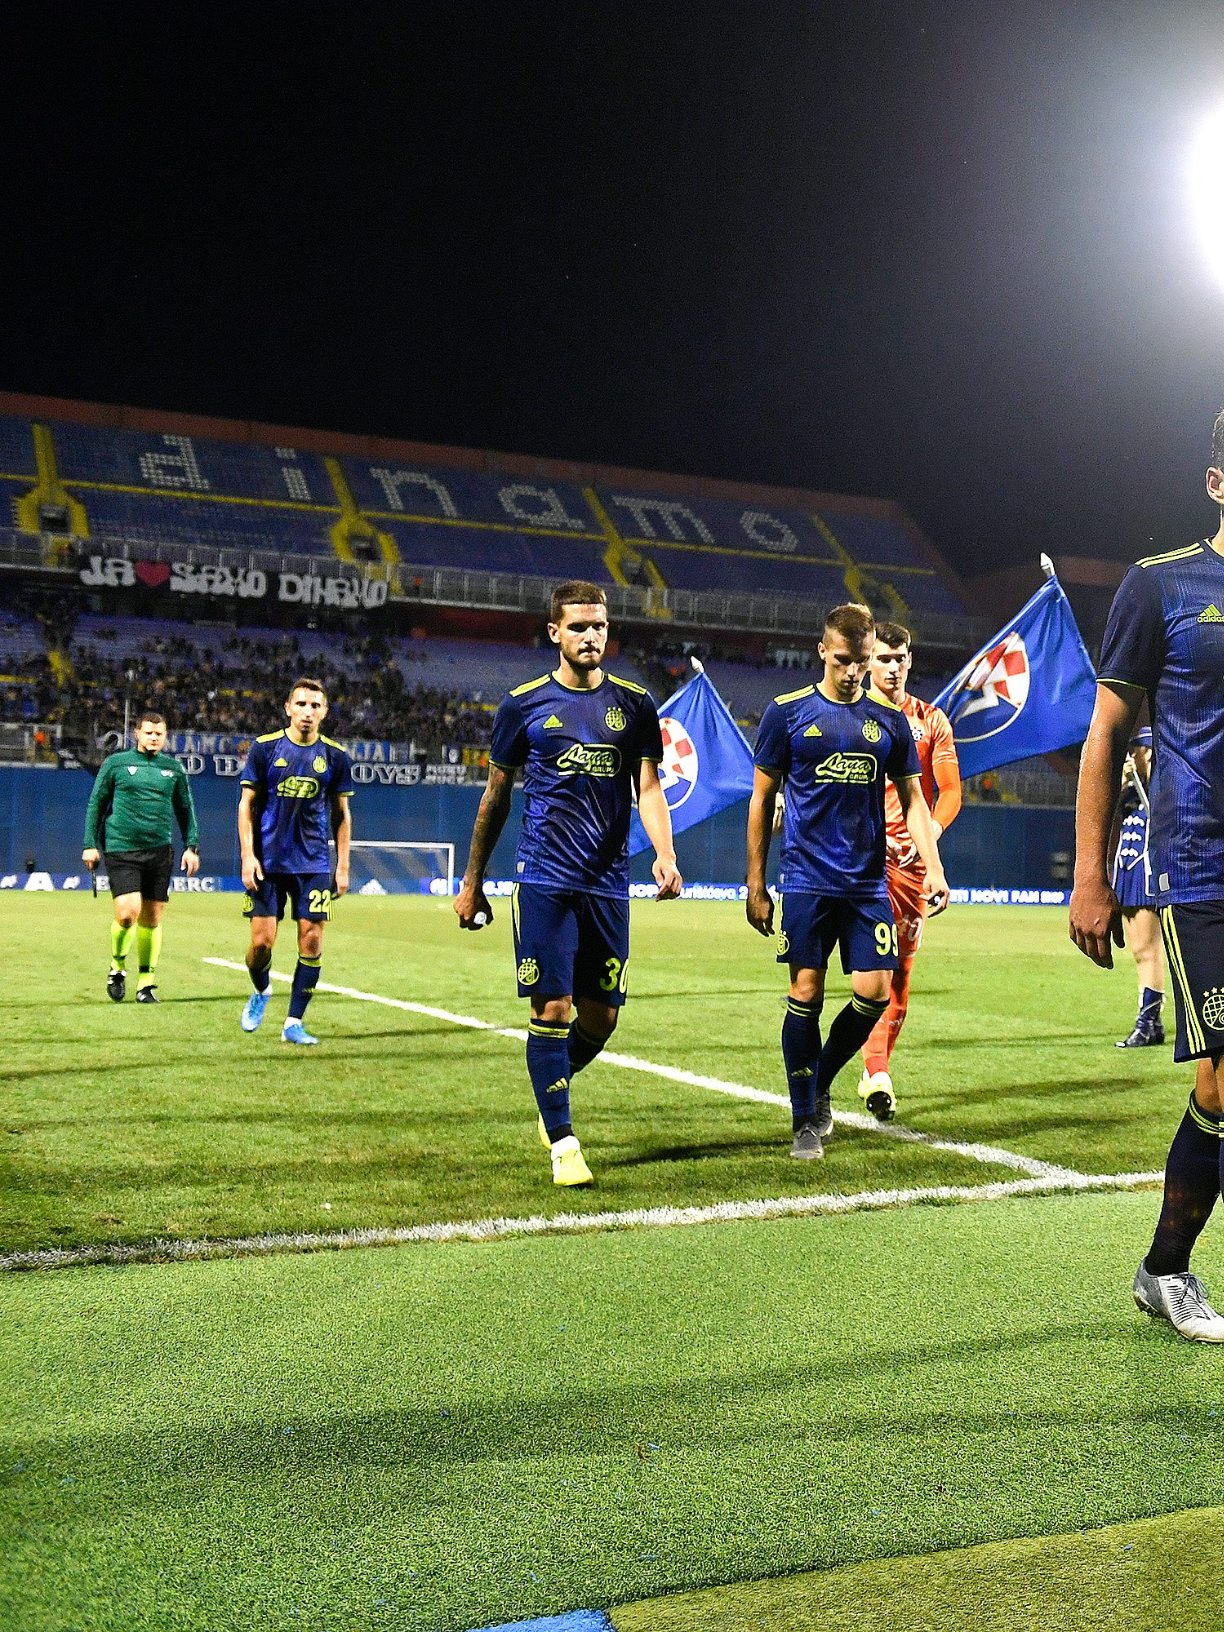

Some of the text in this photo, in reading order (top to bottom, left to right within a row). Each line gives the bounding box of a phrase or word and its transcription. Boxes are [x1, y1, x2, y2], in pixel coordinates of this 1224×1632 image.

[139, 433, 799, 553] dinamo
[80, 556, 389, 610] JA SAMO DINAMO
[350, 762, 421, 786] OYS
[308, 889, 331, 914] 22
[1011, 890, 1040, 904] FAN
